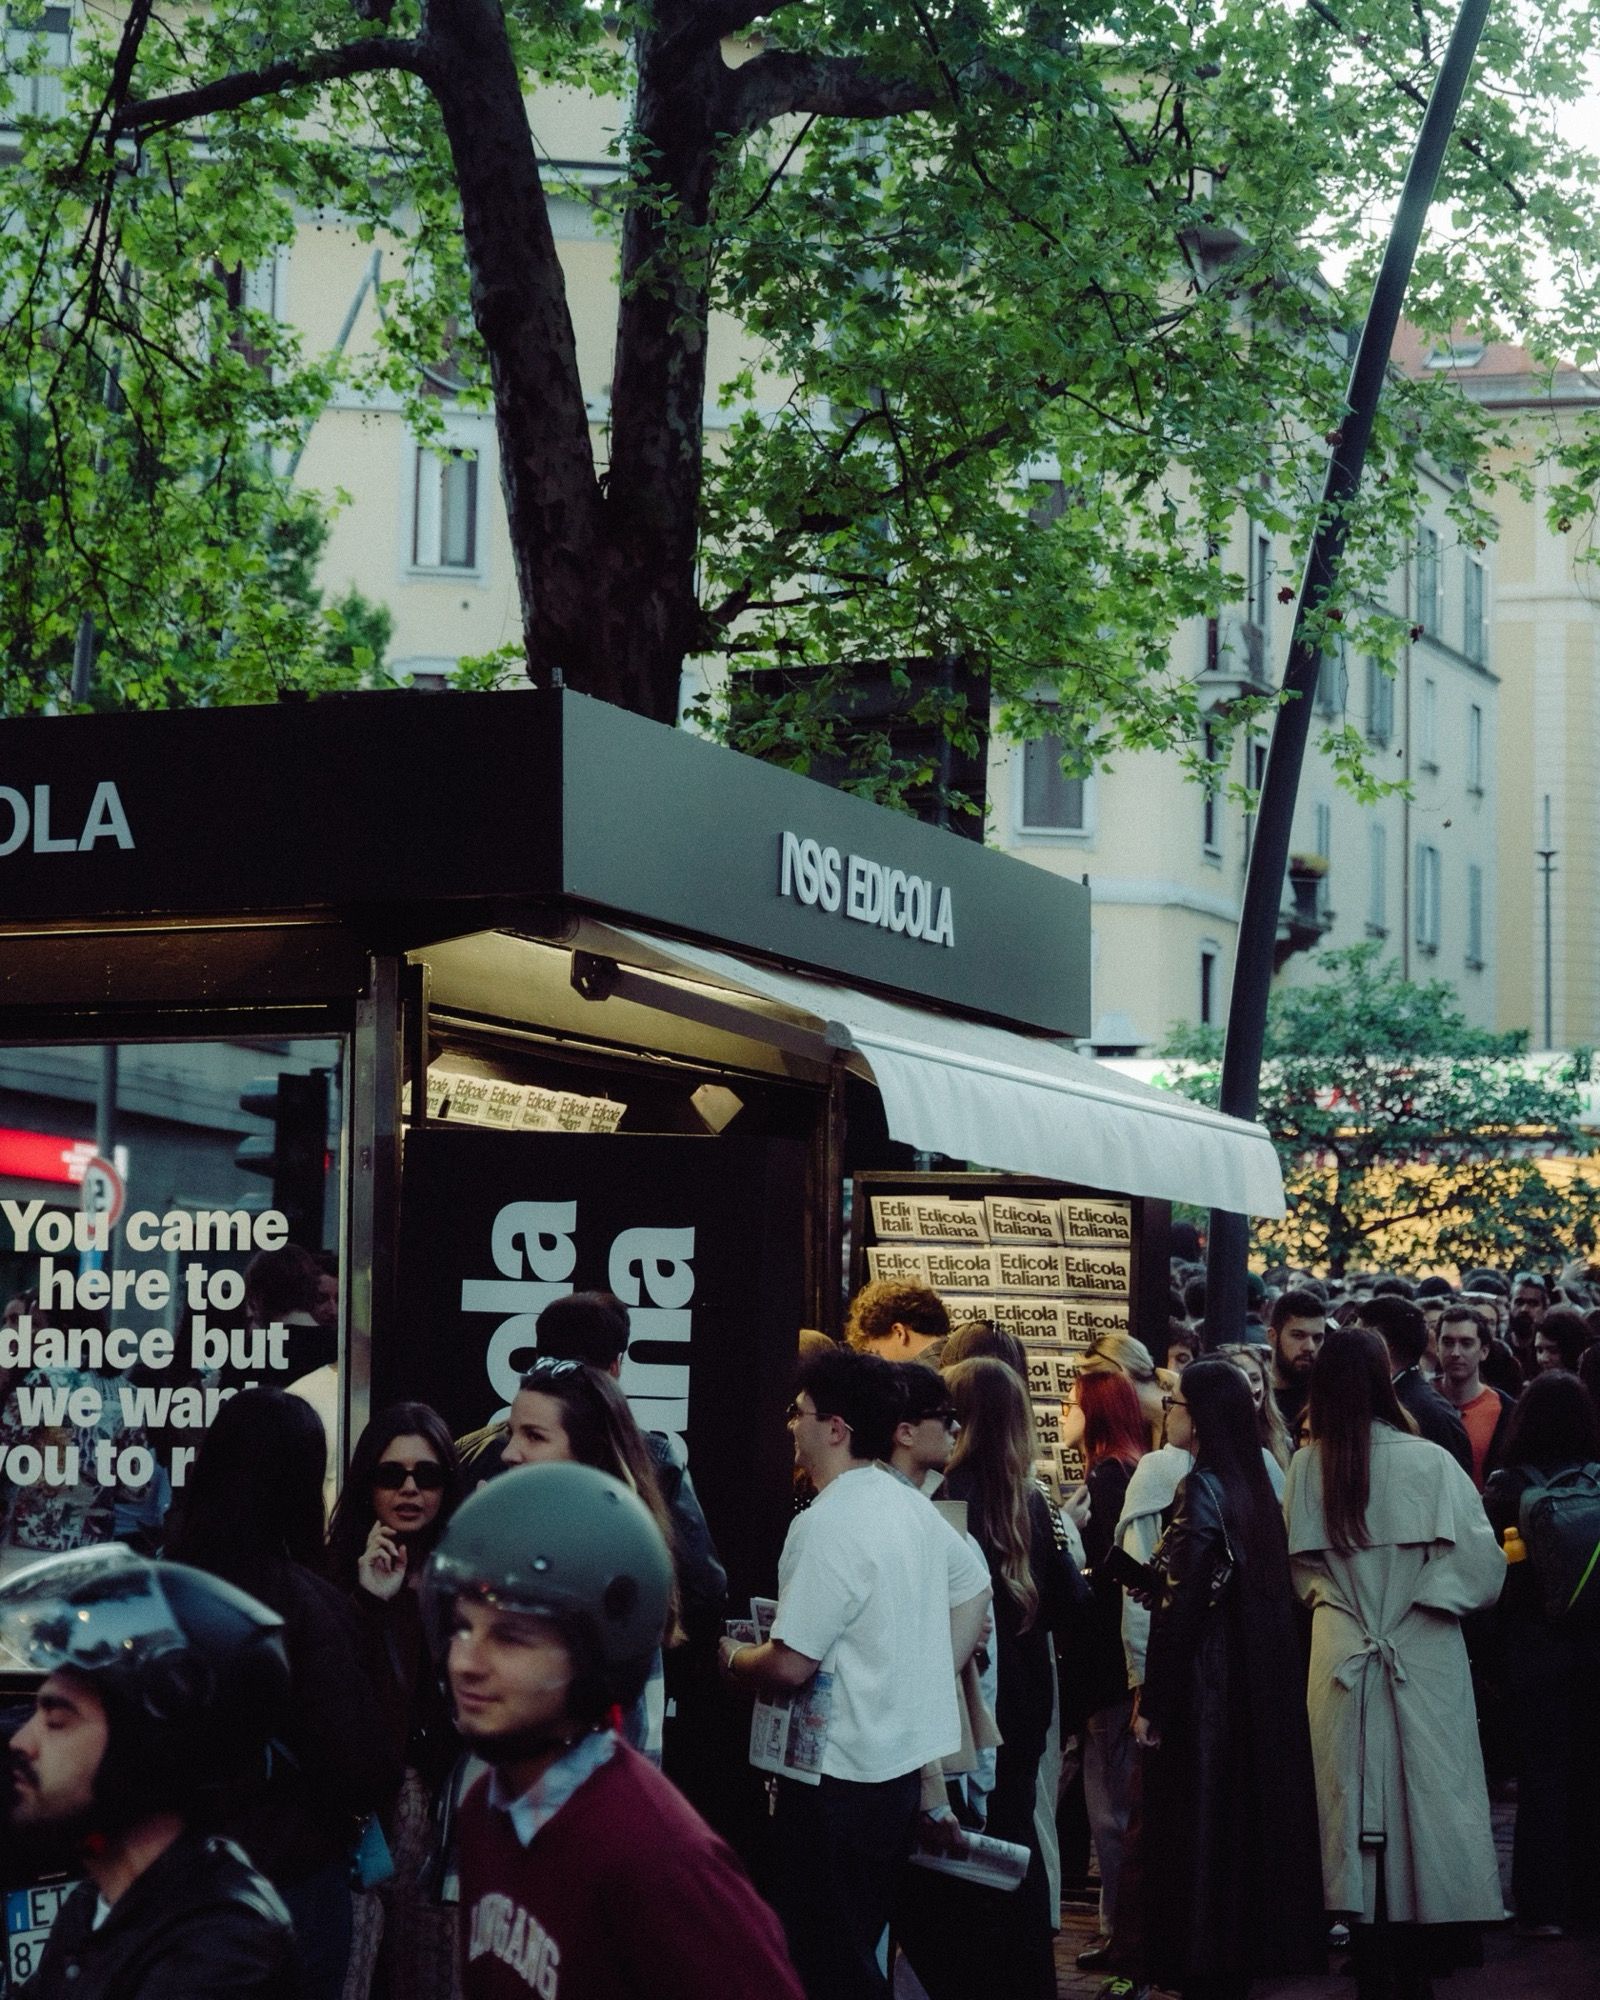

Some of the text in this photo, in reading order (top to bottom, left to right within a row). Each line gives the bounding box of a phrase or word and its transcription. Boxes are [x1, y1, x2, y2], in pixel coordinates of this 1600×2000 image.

[780, 831, 955, 947] NSS EDICOLA
[917, 1207, 978, 1225] Edicola
[992, 1203, 1052, 1225] Edicola
[1067, 1206, 1129, 1226] Edicola
[0, 1199, 290, 1252] You came
[919, 1222, 979, 1238] Italiana
[993, 1219, 1053, 1238] Italiana
[1069, 1222, 1130, 1239] Italiana
[926, 1255, 991, 1270] Edicola
[1064, 1256, 1127, 1277] Edicola
[39, 1257, 246, 1311] here to
[929, 1271, 990, 1287] Italiana
[1001, 1270, 1060, 1287] Italiana
[1065, 1272, 1127, 1291] Italiana
[994, 1304, 1058, 1320] Edicola
[1066, 1310, 1129, 1330] Edicola
[0, 1315, 290, 1370] dance but
[16, 1387, 103, 1428] we
[95, 1439, 155, 1487] to
